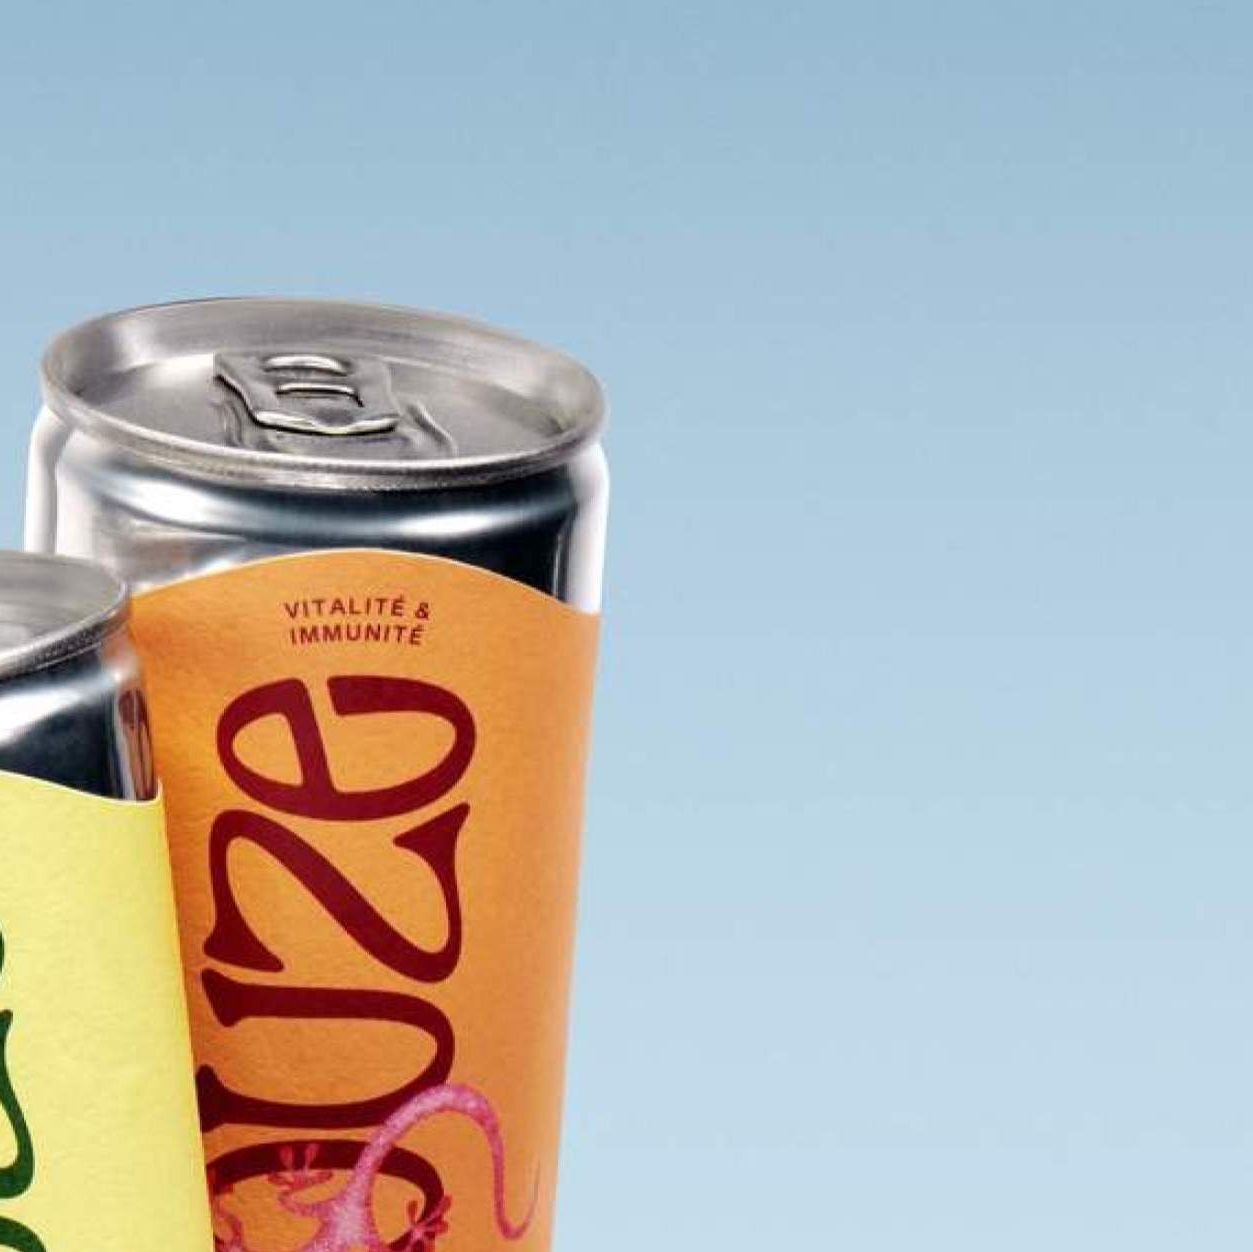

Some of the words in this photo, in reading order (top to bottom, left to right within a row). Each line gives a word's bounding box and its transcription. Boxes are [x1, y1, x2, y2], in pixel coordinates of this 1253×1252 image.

[284, 594, 405, 619] VITALITÉ
[414, 602, 430, 621] &
[290, 623, 425, 646] IMMUNITÉ
